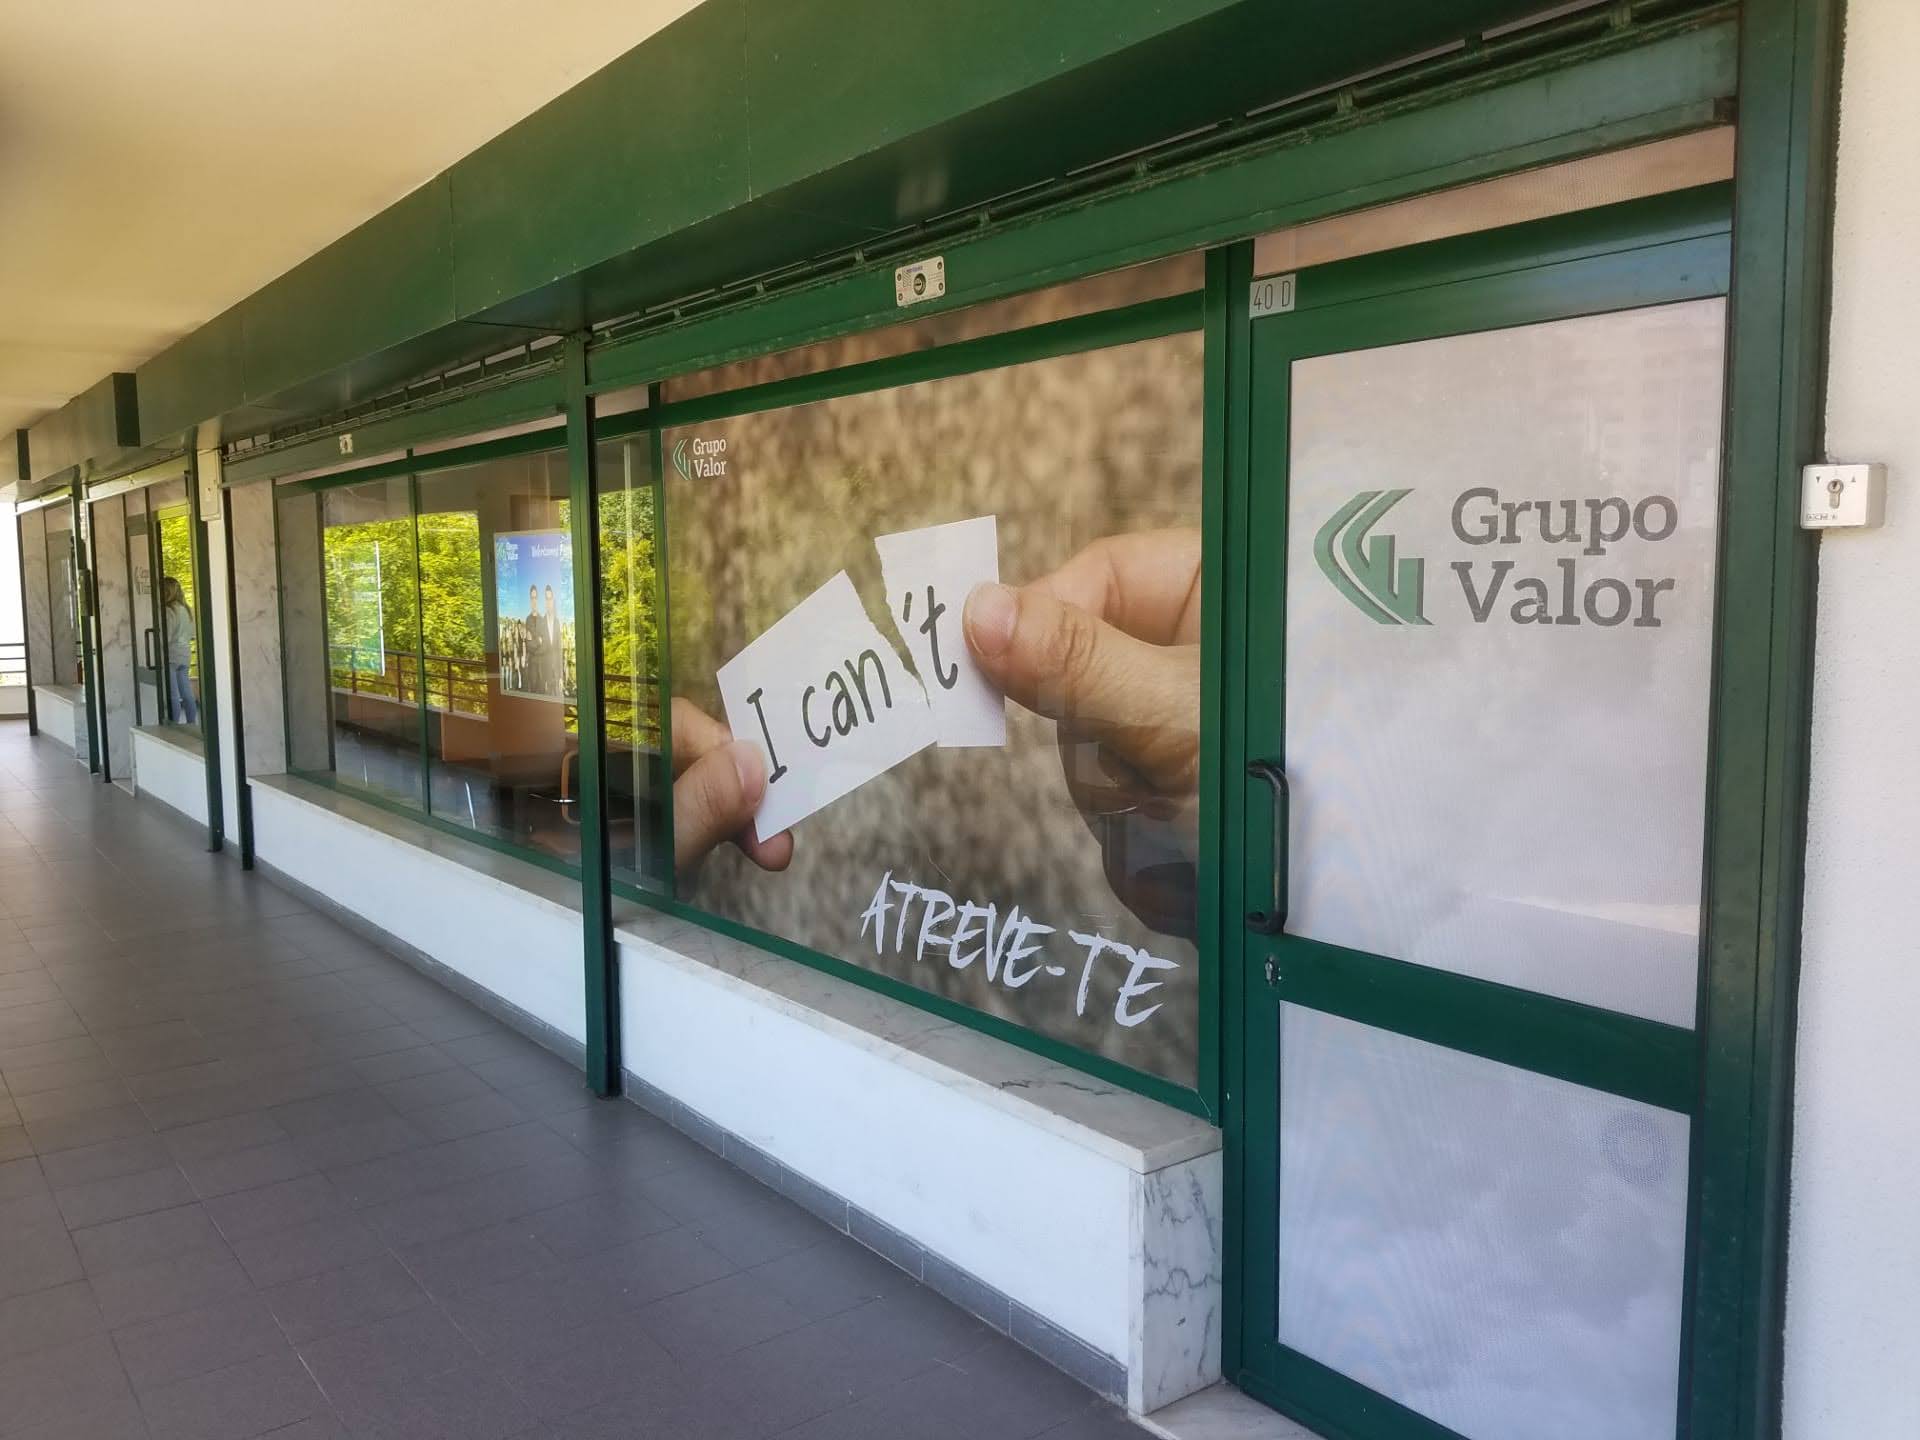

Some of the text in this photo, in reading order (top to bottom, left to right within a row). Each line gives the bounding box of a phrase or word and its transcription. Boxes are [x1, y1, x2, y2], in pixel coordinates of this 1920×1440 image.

[1253, 280, 1291, 311] 40 D
[692, 438, 727, 457] Grupo
[693, 456, 727, 479] Valor
[1450, 486, 1679, 556] Grupo
[1449, 557, 1676, 628] Valor
[746, 687, 788, 784] I
[859, 869, 1181, 1028] ATREVE-TE
